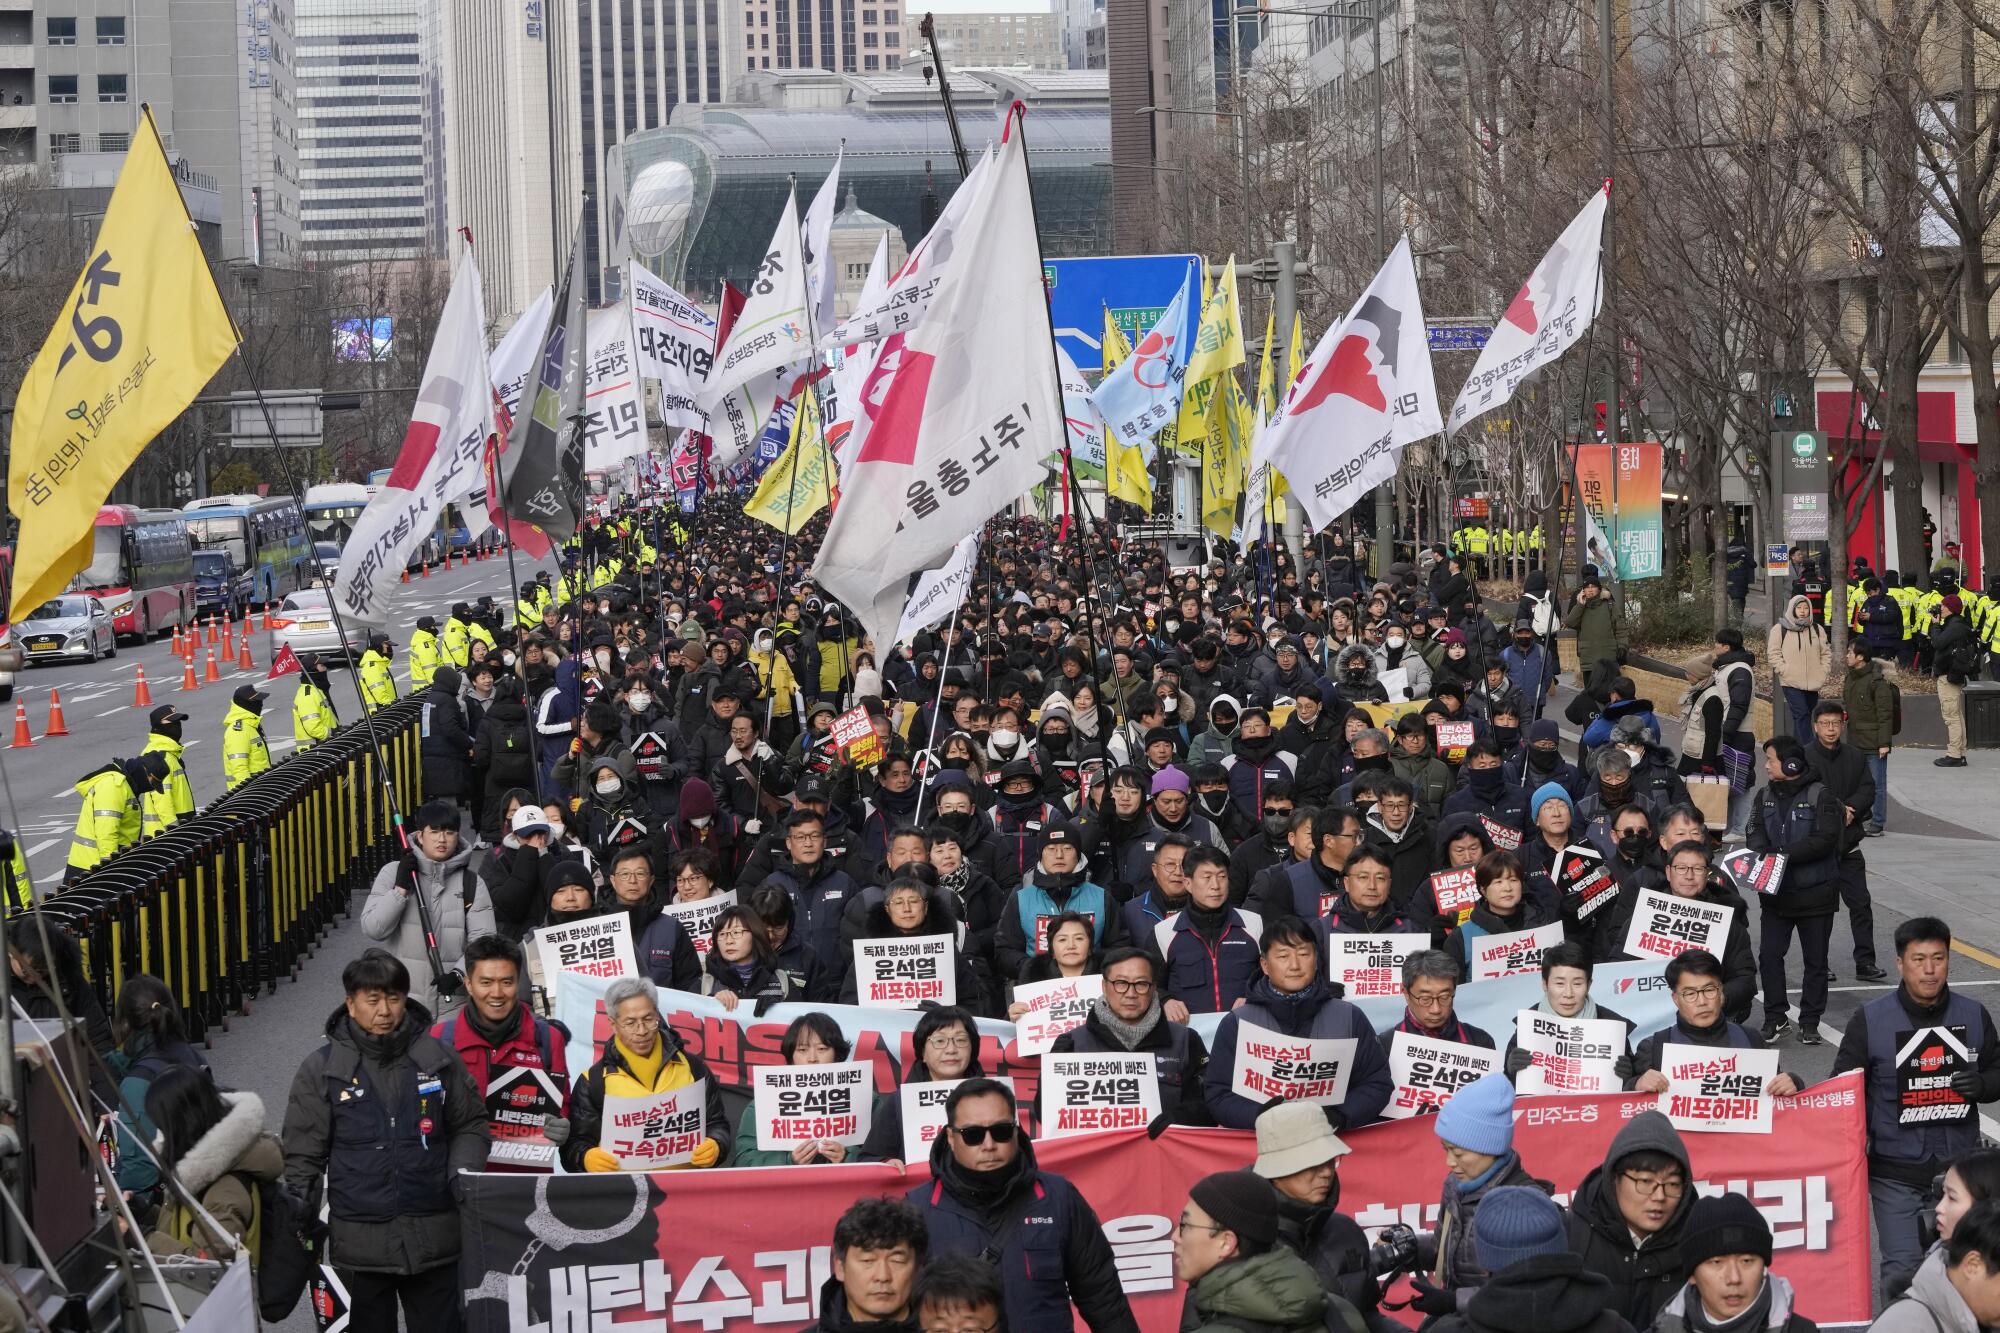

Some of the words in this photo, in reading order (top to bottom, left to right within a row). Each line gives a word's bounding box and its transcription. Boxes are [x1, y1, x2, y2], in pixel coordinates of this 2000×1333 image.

[639, 327, 714, 383] 대전지역
[1792, 457, 1819, 465] 마을버스
[831, 705, 867, 734] 내란수괴
[1437, 722, 1472, 734] 내란수괴
[835, 719, 873, 748] 윤석열
[1438, 734, 1473, 747] 윤석열
[849, 735, 877, 756] 탄핵!
[854, 747, 883, 771] 구속!
[696, 904, 719, 918] 광기에
[1646, 897, 1668, 915] 독재
[1670, 902, 1701, 919] 망상에
[1703, 909, 1723, 924] 빠진
[546, 931, 568, 944] 독재
[570, 923, 600, 940] 망상에
[602, 920, 621, 935] 빠진
[1649, 913, 1711, 945] 윤석열
[559, 935, 616, 966] 윤석열
[864, 945, 886, 957] 독재
[888, 944, 921, 956] 망상에
[923, 942, 945, 955] 빠진
[1343, 940, 1393, 954] 민주노총
[1481, 933, 1536, 962] 내란수괴
[875, 957, 937, 980] 윤석열
[1506, 949, 1543, 970] 윤석
[1343, 968, 1392, 982] 윤석열을
[870, 980, 943, 1000] 체포하라!
[1533, 1018, 1585, 1042] 민주노총
[1246, 1041, 1312, 1062] 내란수괴
[1406, 1046, 1438, 1062] 망상과
[1440, 1050, 1470, 1066] 광기에
[1471, 1058, 1490, 1072] 빠진
[1530, 1051, 1582, 1074] 윤석열을
[1555, 1041, 1612, 1061] 이름으로
[765, 1073, 792, 1089] 독재
[795, 1071, 834, 1087] 망상에
[837, 1068, 862, 1085] 빠진
[1053, 1062, 1079, 1076] 독재
[1084, 1061, 1123, 1076] 망상에
[1125, 1060, 1148, 1076] 빠진
[1271, 1059, 1339, 1082] 윤석열
[1672, 1053, 1737, 1081] 내란수괴
[1066, 1078, 1141, 1106] 윤석열
[1243, 1067, 1335, 1101] 체포하라!
[1543, 1069, 1600, 1092] 체포한다!
[1700, 1074, 1763, 1098] 윤석열
[778, 1088, 851, 1116] 윤석열
[919, 1089, 951, 1107] 민주
[1669, 1095, 1758, 1121] 체포하라!
[1801, 1089, 1856, 1110] 비상행동
[614, 1094, 678, 1129] 내란수괴
[643, 1107, 701, 1139] 윤석열
[1057, 1107, 1148, 1130] 체포하라!
[1527, 1104, 1599, 1127] 민주노총
[1899, 1105, 1970, 1124] 해체하라!
[770, 1115, 857, 1140] 체포하라!
[612, 1132, 701, 1160] 구속하라!
